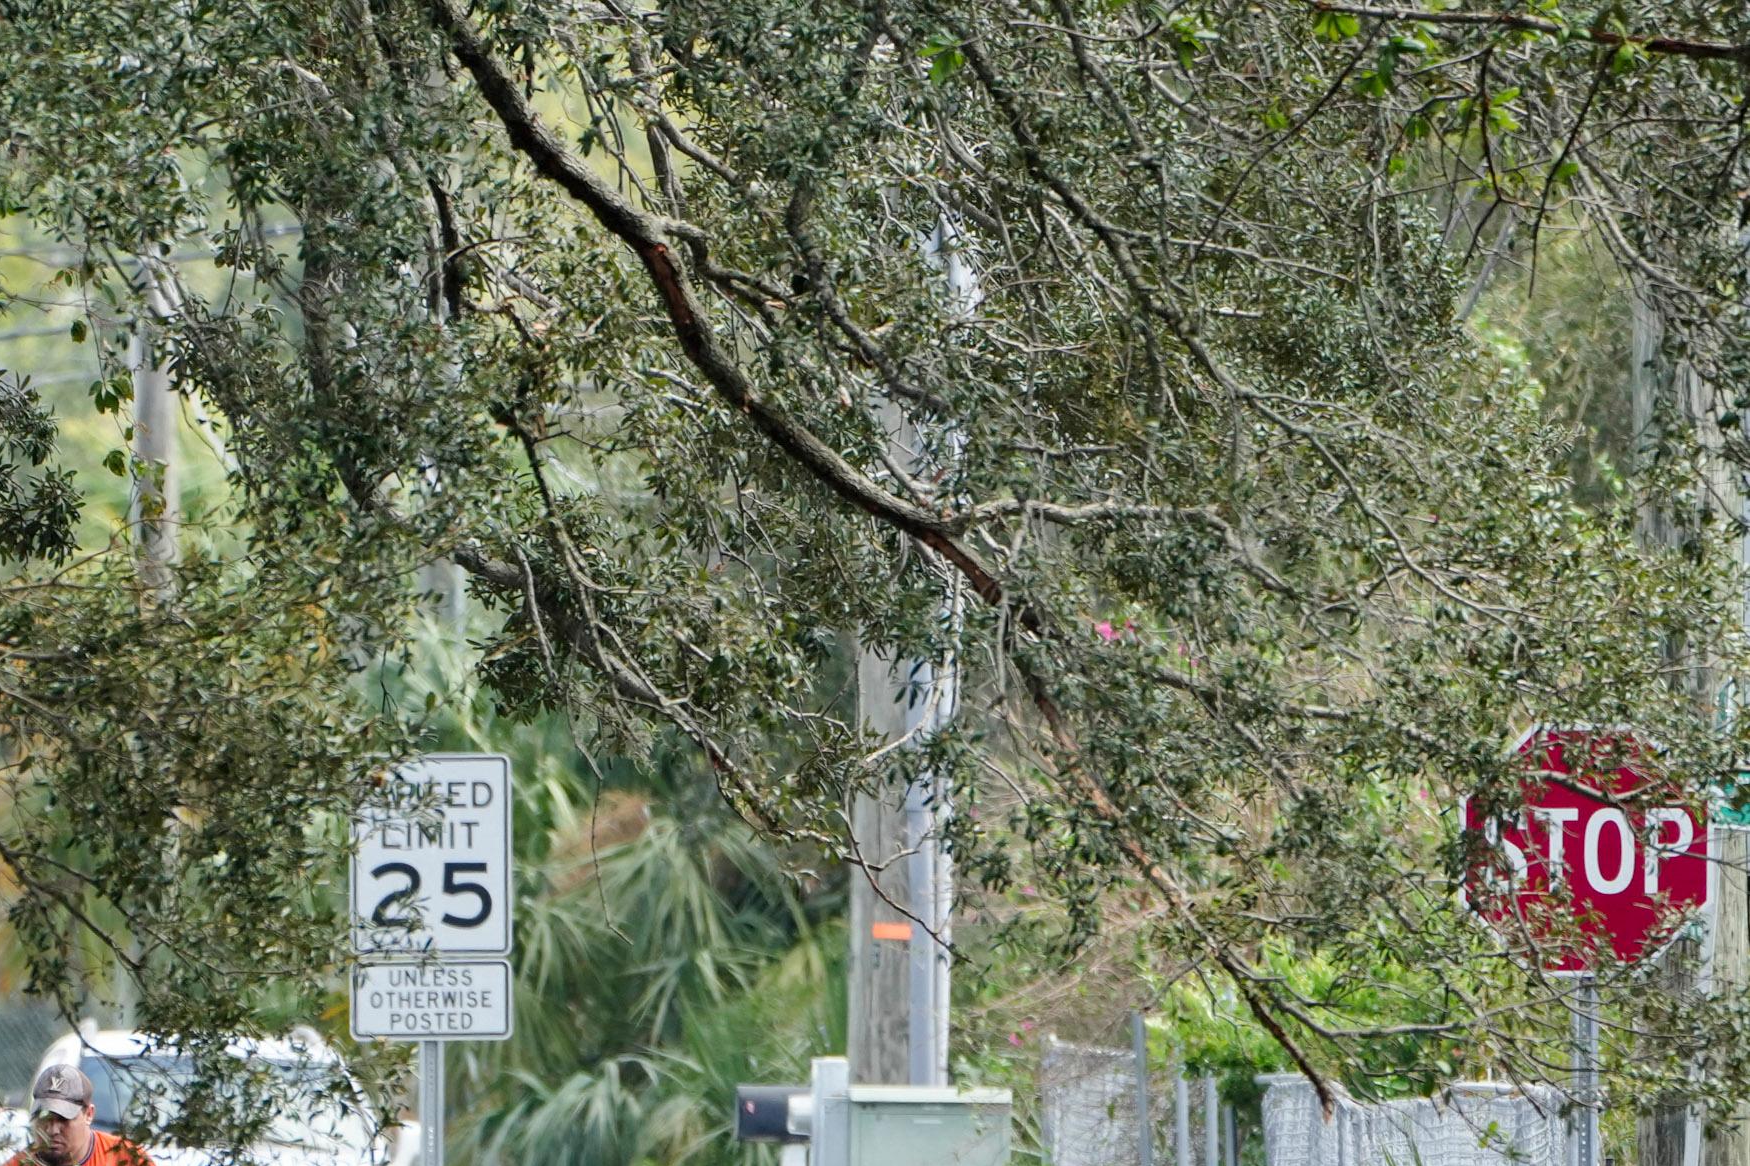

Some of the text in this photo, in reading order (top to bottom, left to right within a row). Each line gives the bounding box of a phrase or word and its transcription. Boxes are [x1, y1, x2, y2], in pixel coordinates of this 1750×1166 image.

[373, 781, 493, 808] PED
[382, 821, 480, 850] LIMIT
[371, 862, 493, 928] 25
[388, 969, 472, 987] UNLESS
[370, 991, 493, 1009] OTHERWISE
[390, 1012, 474, 1031] POSTED
